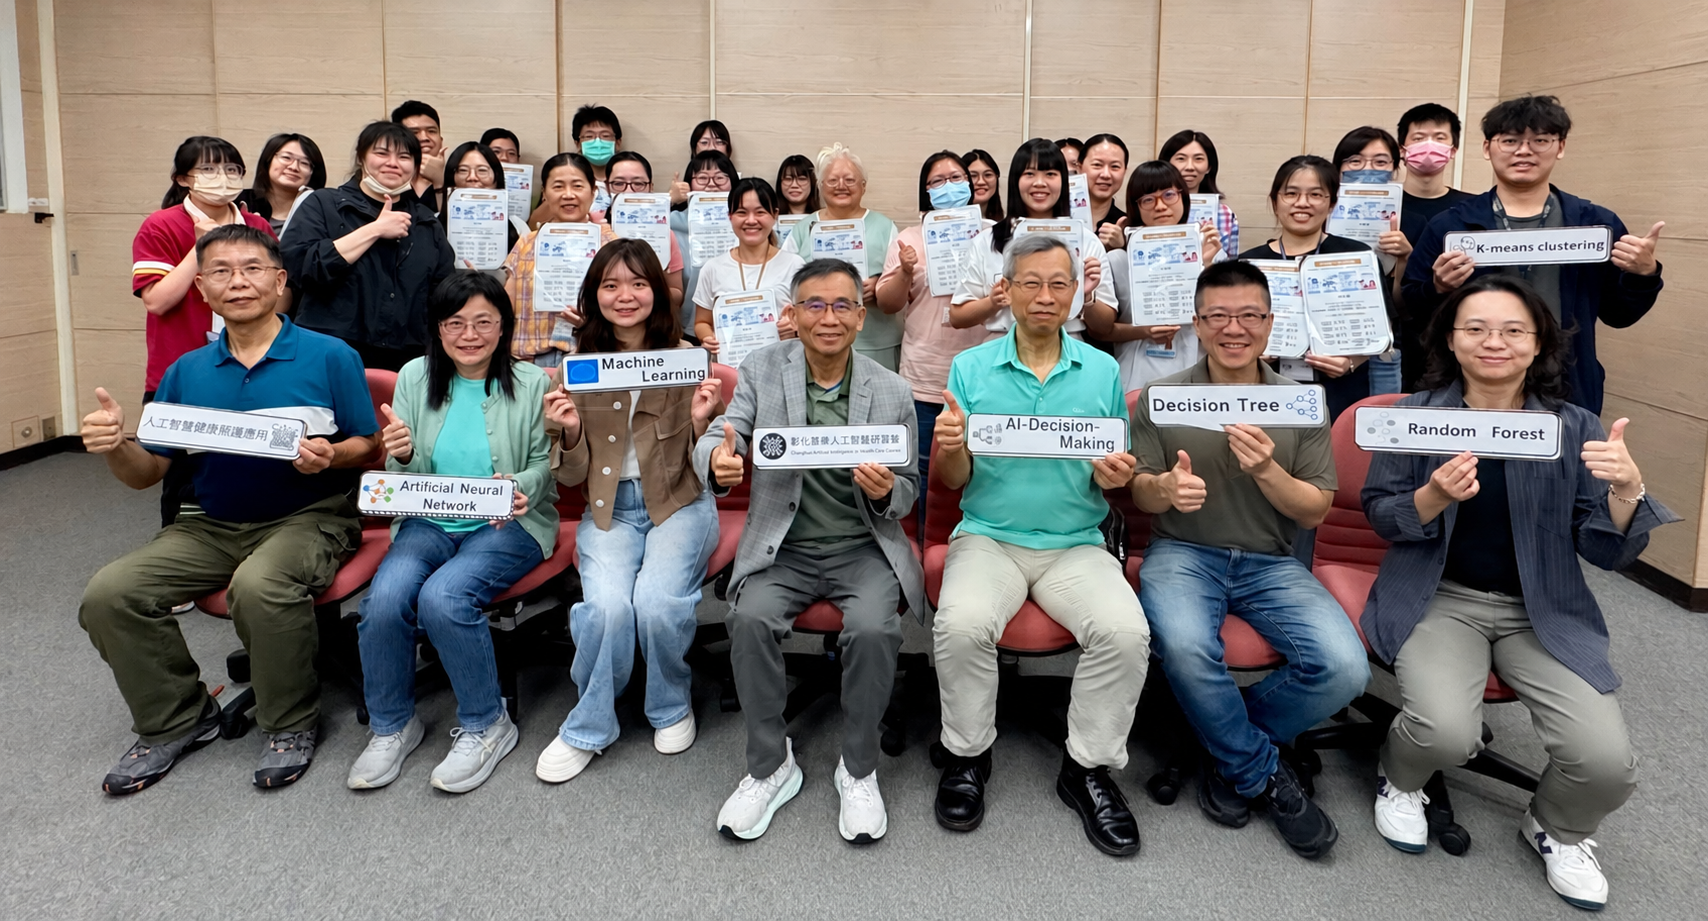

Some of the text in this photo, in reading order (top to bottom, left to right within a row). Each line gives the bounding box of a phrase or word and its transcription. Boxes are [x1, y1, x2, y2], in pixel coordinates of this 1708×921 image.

[1476, 240, 1605, 254] K-means clustering
[602, 355, 664, 370] Machine
[642, 368, 706, 383] Learning
[1153, 398, 1280, 412] Decision Tree
[143, 416, 269, 442] 人工智慧健康照護應用
[1006, 417, 1100, 433] AI-Decision-
[1408, 422, 1546, 441] Random Forest
[1060, 435, 1115, 453] Making
[400, 480, 503, 496] Artificial Neural
[423, 498, 477, 512] Network
